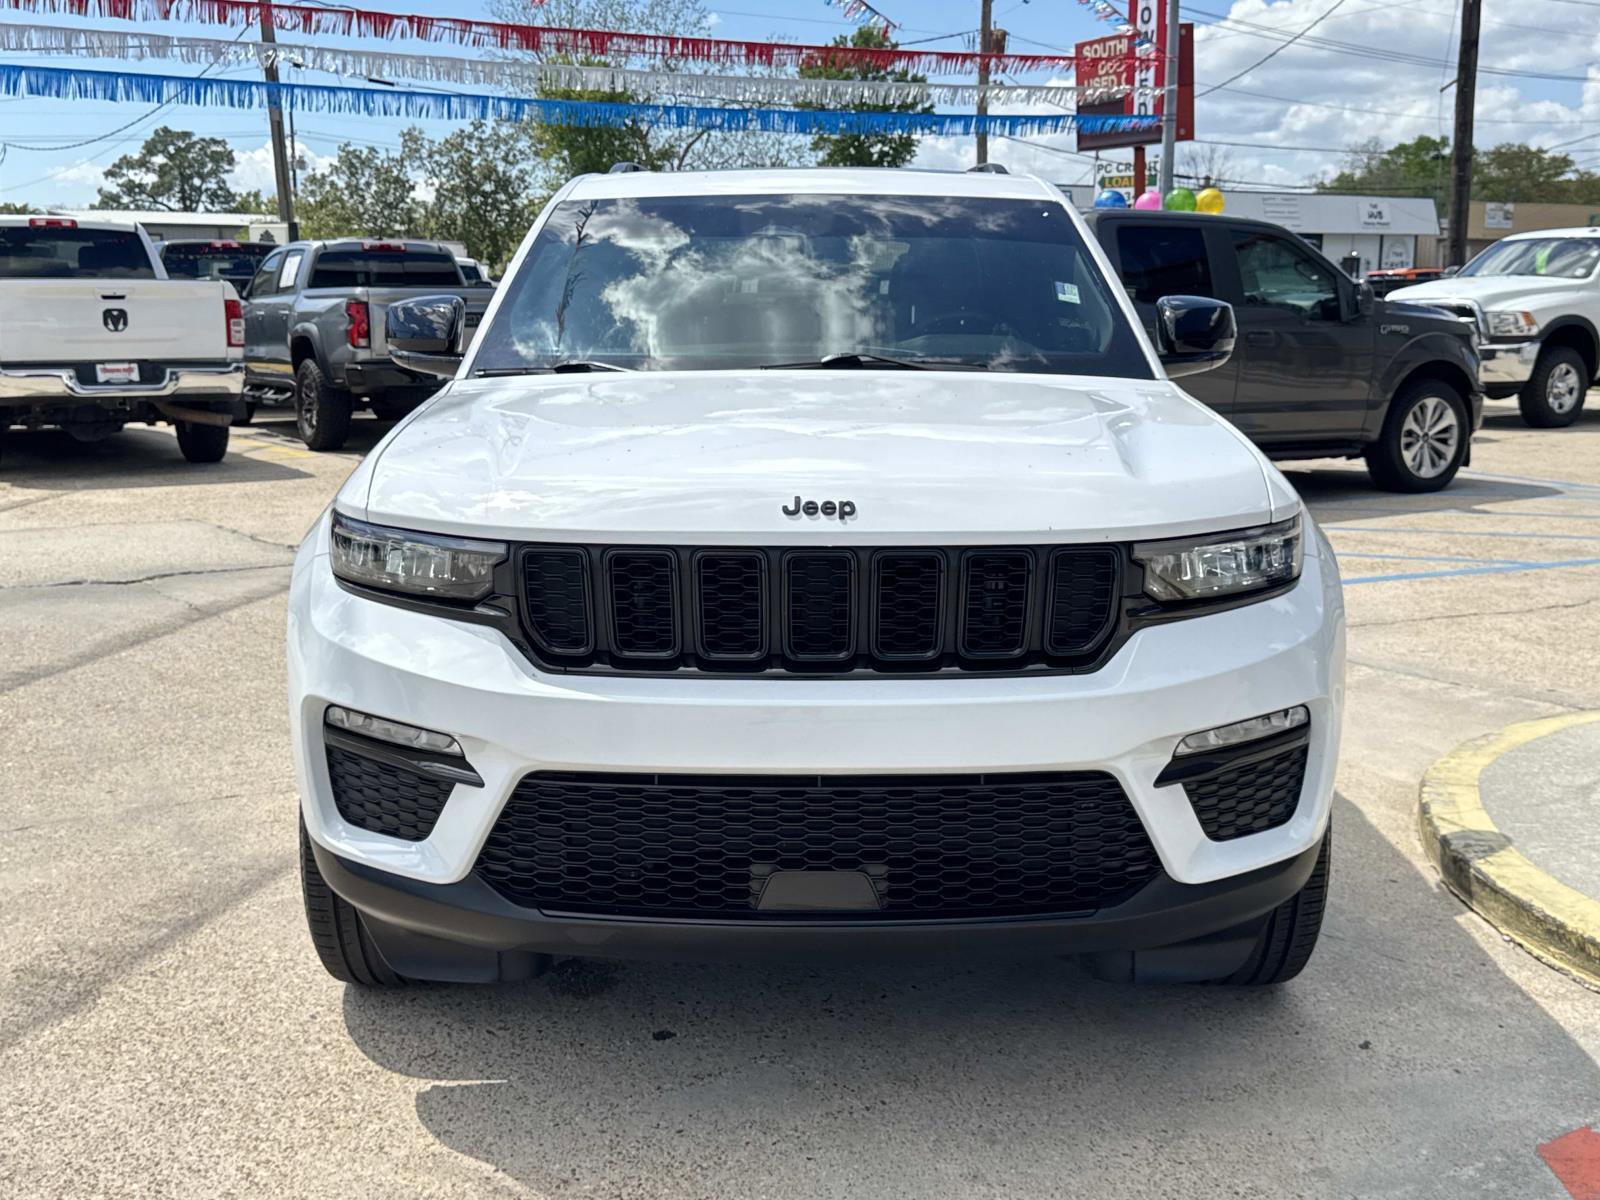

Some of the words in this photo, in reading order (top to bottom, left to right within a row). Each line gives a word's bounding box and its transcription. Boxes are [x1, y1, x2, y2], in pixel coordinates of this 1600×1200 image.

[1116, 160, 1159, 172] CRIT
[1104, 176, 1148, 188] LOA
[782, 495, 856, 520] Jeep
